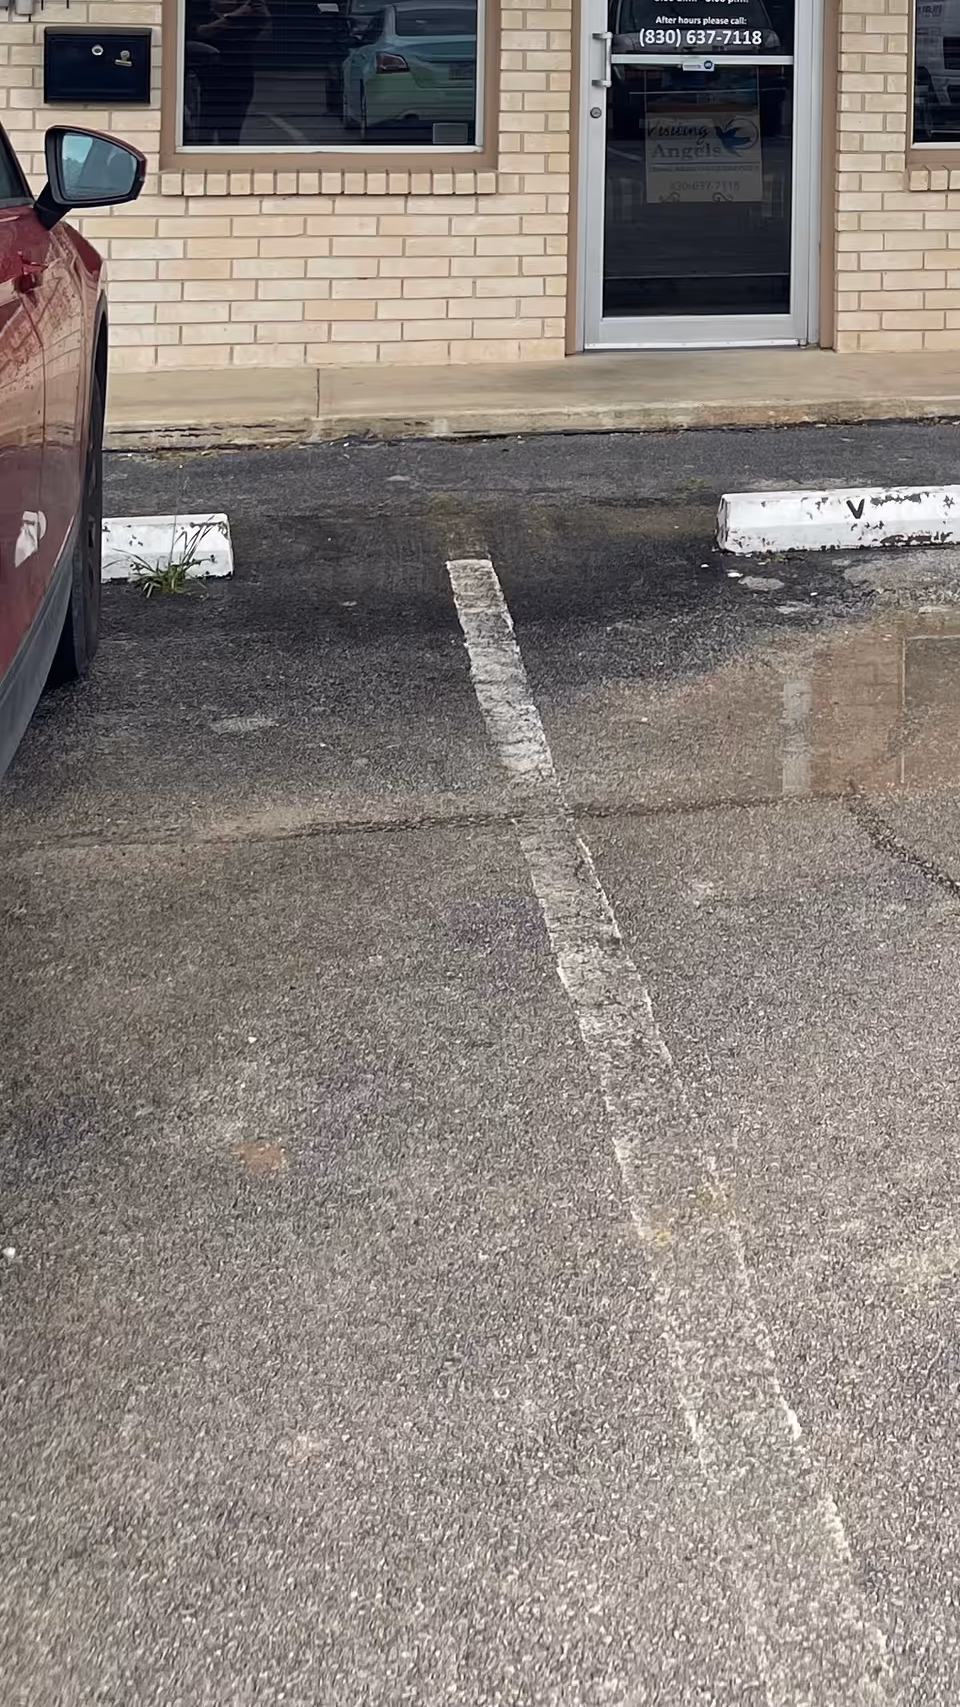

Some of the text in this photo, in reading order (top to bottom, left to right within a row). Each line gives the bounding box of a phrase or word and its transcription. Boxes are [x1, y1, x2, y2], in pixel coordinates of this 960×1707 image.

[655, 16, 748, 26] After hours please call:
[639, 28, 762, 47] (830) 637-7118
[846, 499, 865, 519] V
